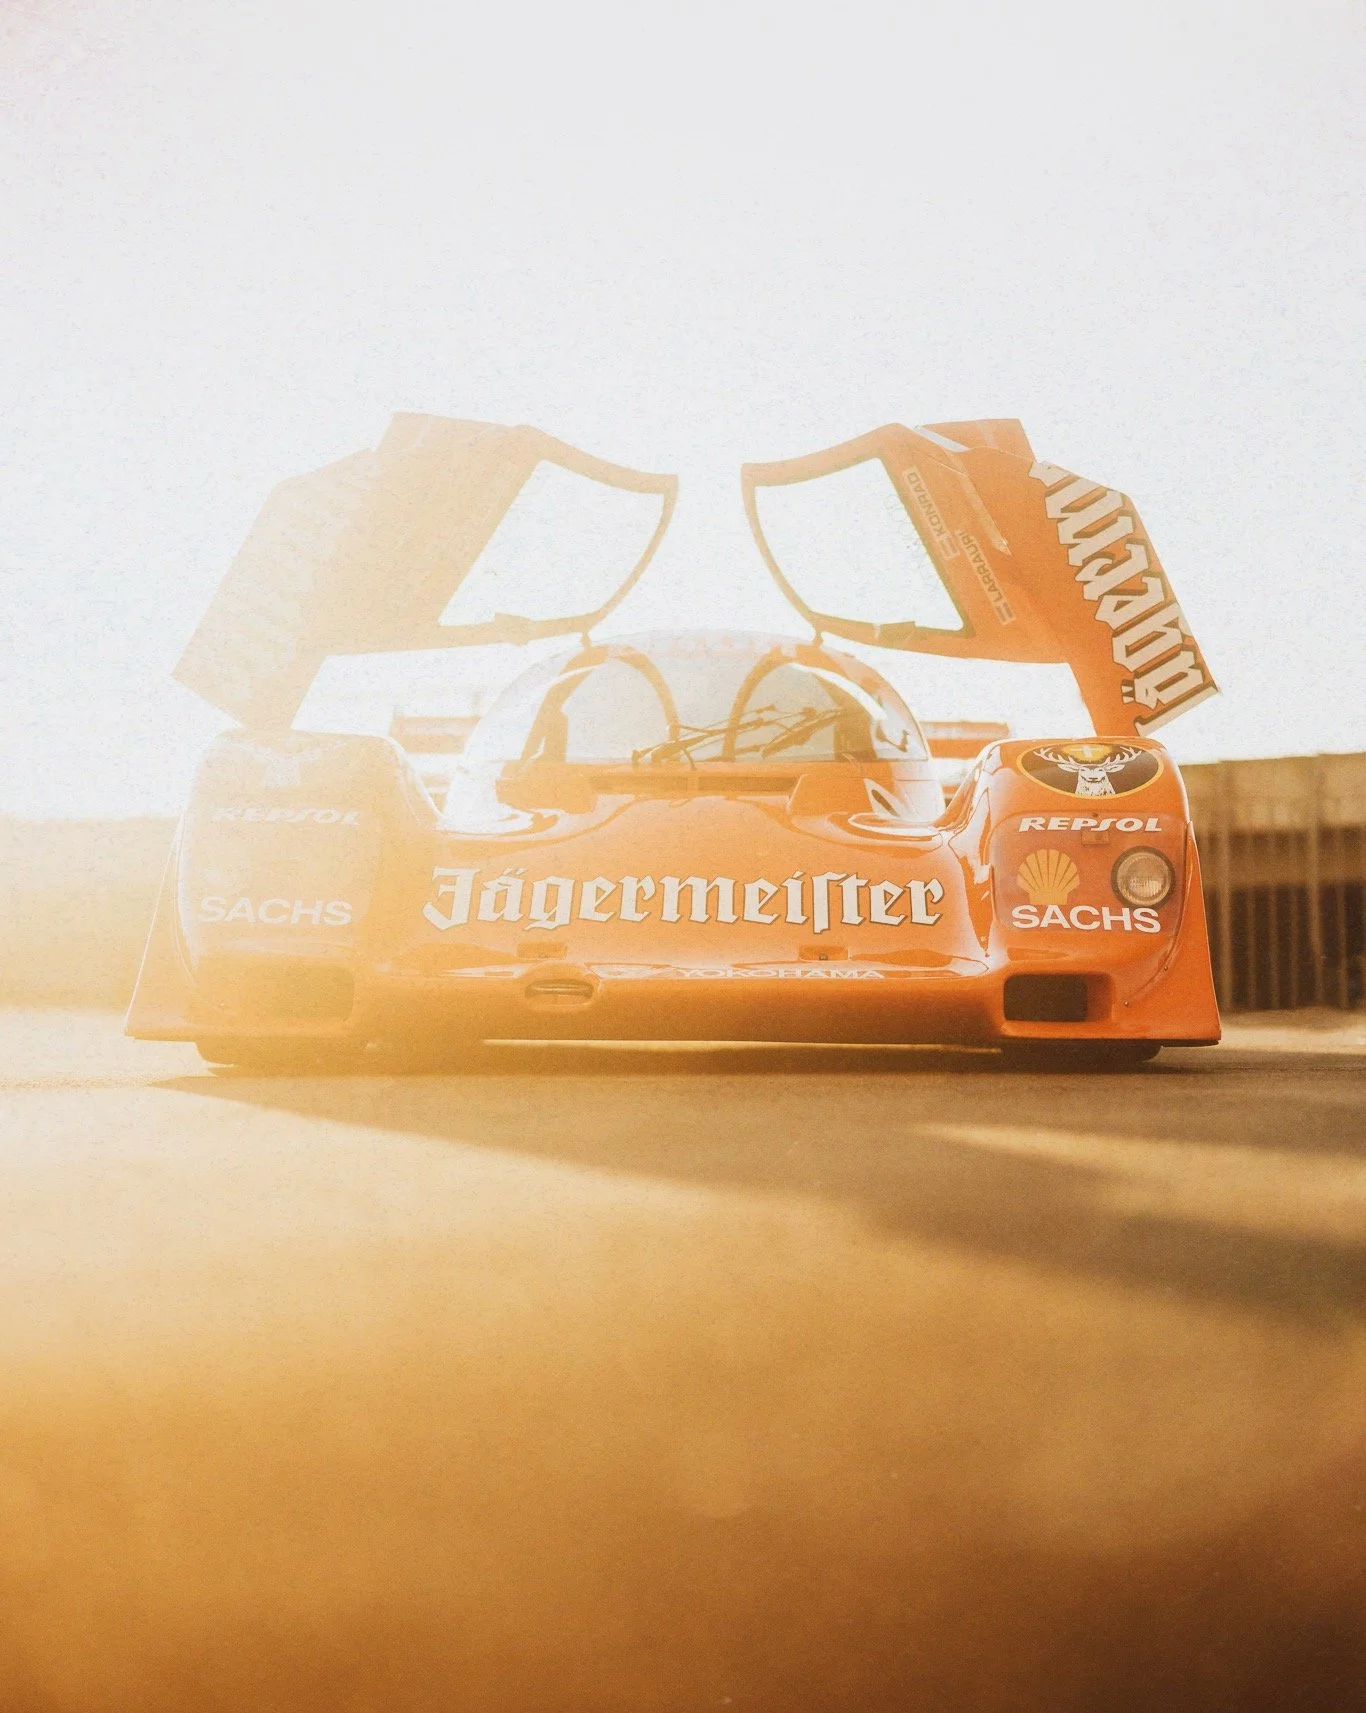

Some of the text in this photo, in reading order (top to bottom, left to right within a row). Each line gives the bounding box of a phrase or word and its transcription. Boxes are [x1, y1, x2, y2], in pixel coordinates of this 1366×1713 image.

[907, 471, 946, 537] KONRAD
[1028, 460, 1220, 737] ägerm
[213, 807, 360, 826] REPSOL
[1018, 816, 1163, 833] REPSOL
[198, 896, 353, 926] SACHS
[1011, 904, 1161, 933] SACHS
[675, 968, 885, 979] YOKOHAMA
